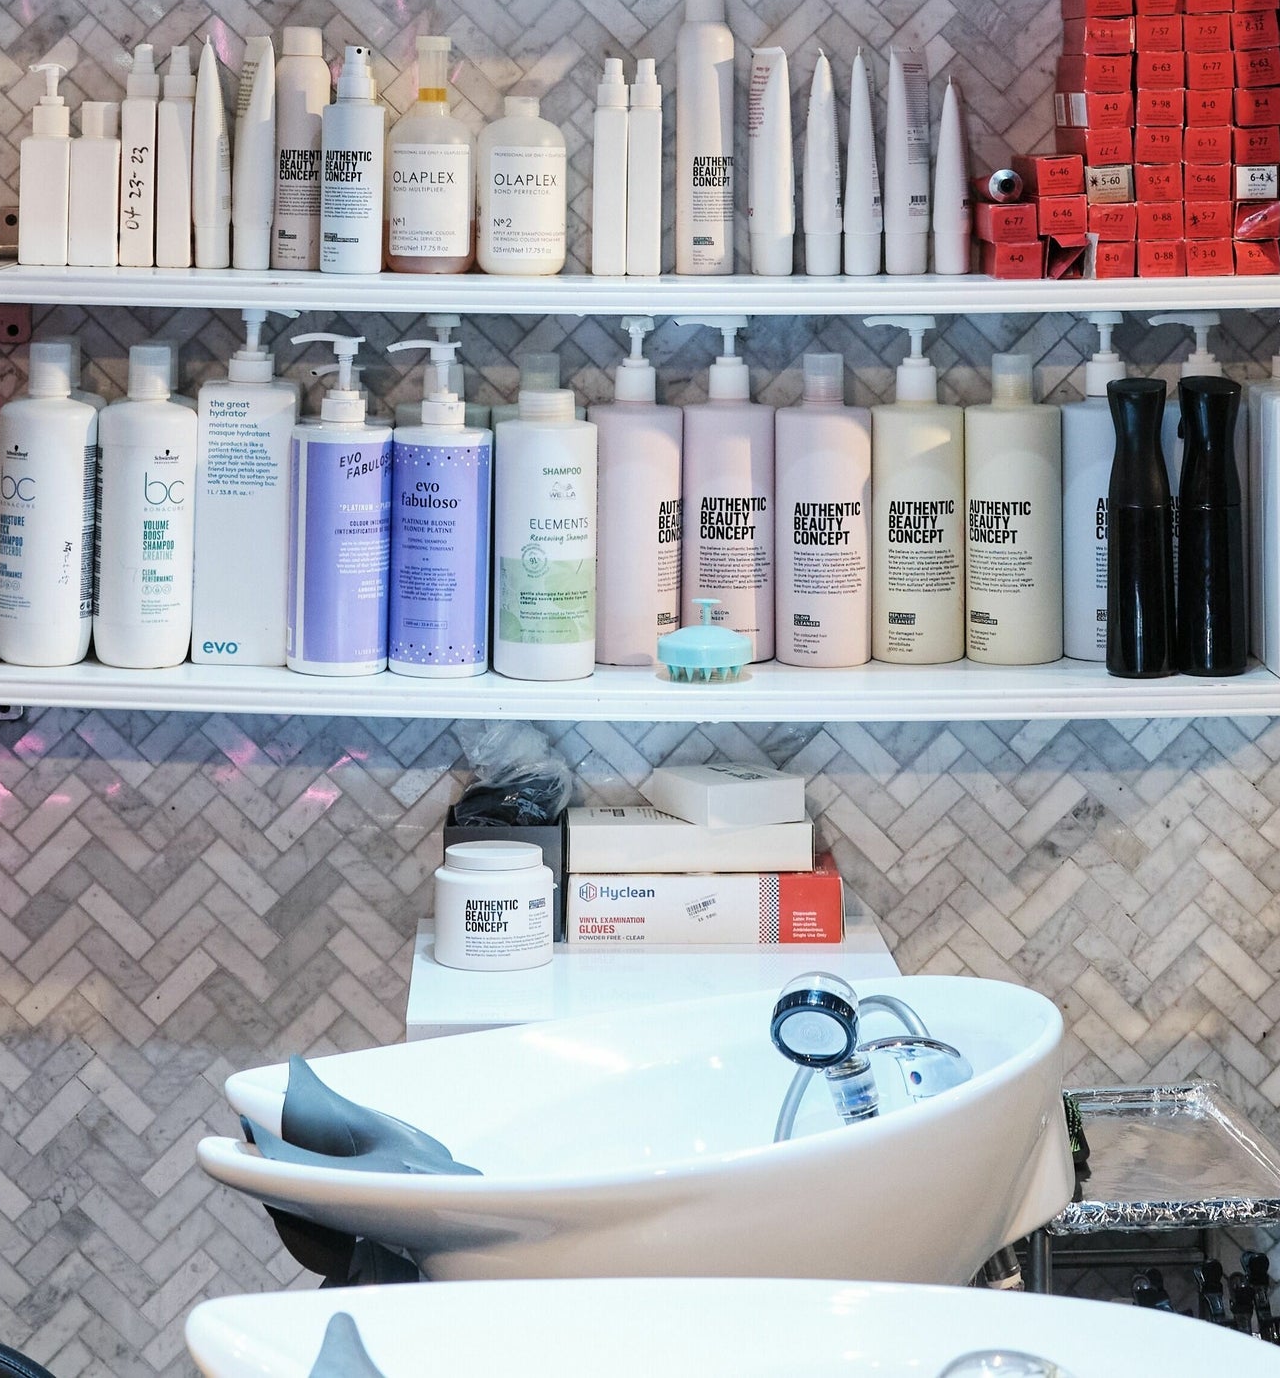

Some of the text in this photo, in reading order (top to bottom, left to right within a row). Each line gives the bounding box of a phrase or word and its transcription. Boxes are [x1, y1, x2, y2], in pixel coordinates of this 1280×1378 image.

[1198, 25, 1217, 35] 7-57
[1152, 63, 1171, 72] 6-63
[1202, 62, 1222, 71] 6-77
[1104, 102, 1118, 111] 4-0
[1201, 100, 1216, 109] 4-0
[1150, 134, 1170, 143] 9-19
[325, 150, 372, 162] AUTHENTIC
[279, 159, 315, 170] BEAUTY
[325, 161, 358, 172] BEAUTY
[279, 170, 319, 181] CONCEPT
[325, 171, 362, 182] CONCEPT
[692, 166, 728, 177] BEAUTY
[1049, 168, 1069, 176] 6-46
[1250, 173, 1265, 181] 6-4
[393, 171, 455, 184] OLAPLEX
[494, 173, 557, 187] OLAPLEX
[692, 176, 731, 187] CONCEPT
[1101, 176, 1120, 185] 5-60
[1196, 175, 1216, 183] 6-46
[1052, 209, 1073, 218] 6-46
[1152, 212, 1172, 221] 0-88
[1202, 211, 1216, 220] 5-7
[1004, 217, 1024, 225] 6-77
[1009, 254, 1024, 263] 4-0
[1104, 253, 1119, 262] 8-0
[1154, 251, 1174, 260] 0-88
[1202, 249, 1216, 259] 3-0
[210, 400, 250, 410] the great
[209, 409, 247, 418] hydrator
[236, 430, 271, 438] hydratant
[339, 451, 362, 468] EVO
[542, 467, 582, 476] SHAMPOO
[0, 465, 36, 502] bc
[144, 471, 185, 505] bc
[415, 482, 440, 493] evo
[701, 496, 767, 512] AUTHENTIC
[794, 501, 861, 517] AUTHENTIC
[889, 500, 955, 515] AUTHENTIC
[969, 499, 1032, 516] AUTHENTIC
[431, 519, 457, 527] BLONDE
[529, 517, 589, 530] ELEMENTS
[700, 511, 750, 526] BEAUTY
[793, 516, 844, 531] BEAUTY
[888, 514, 938, 530] BEAUTY
[969, 512, 1010, 530] BEAUTY
[143, 520, 169, 530] VOLUME
[143, 530, 165, 540] BOOST
[700, 525, 756, 540] CONCEPT
[793, 530, 850, 545] CONCEPT
[888, 528, 944, 544] CONCEPT
[969, 527, 1018, 544] CONCEPT
[142, 540, 175, 550] SHAMPOO
[202, 640, 239, 655] evo
[600, 886, 655, 901] Hyclean
[465, 899, 519, 911] AUTHENTIC
[465, 910, 503, 922] BEAUTY
[465, 921, 509, 933] CONCEPT
[579, 924, 615, 934] GLOVES
